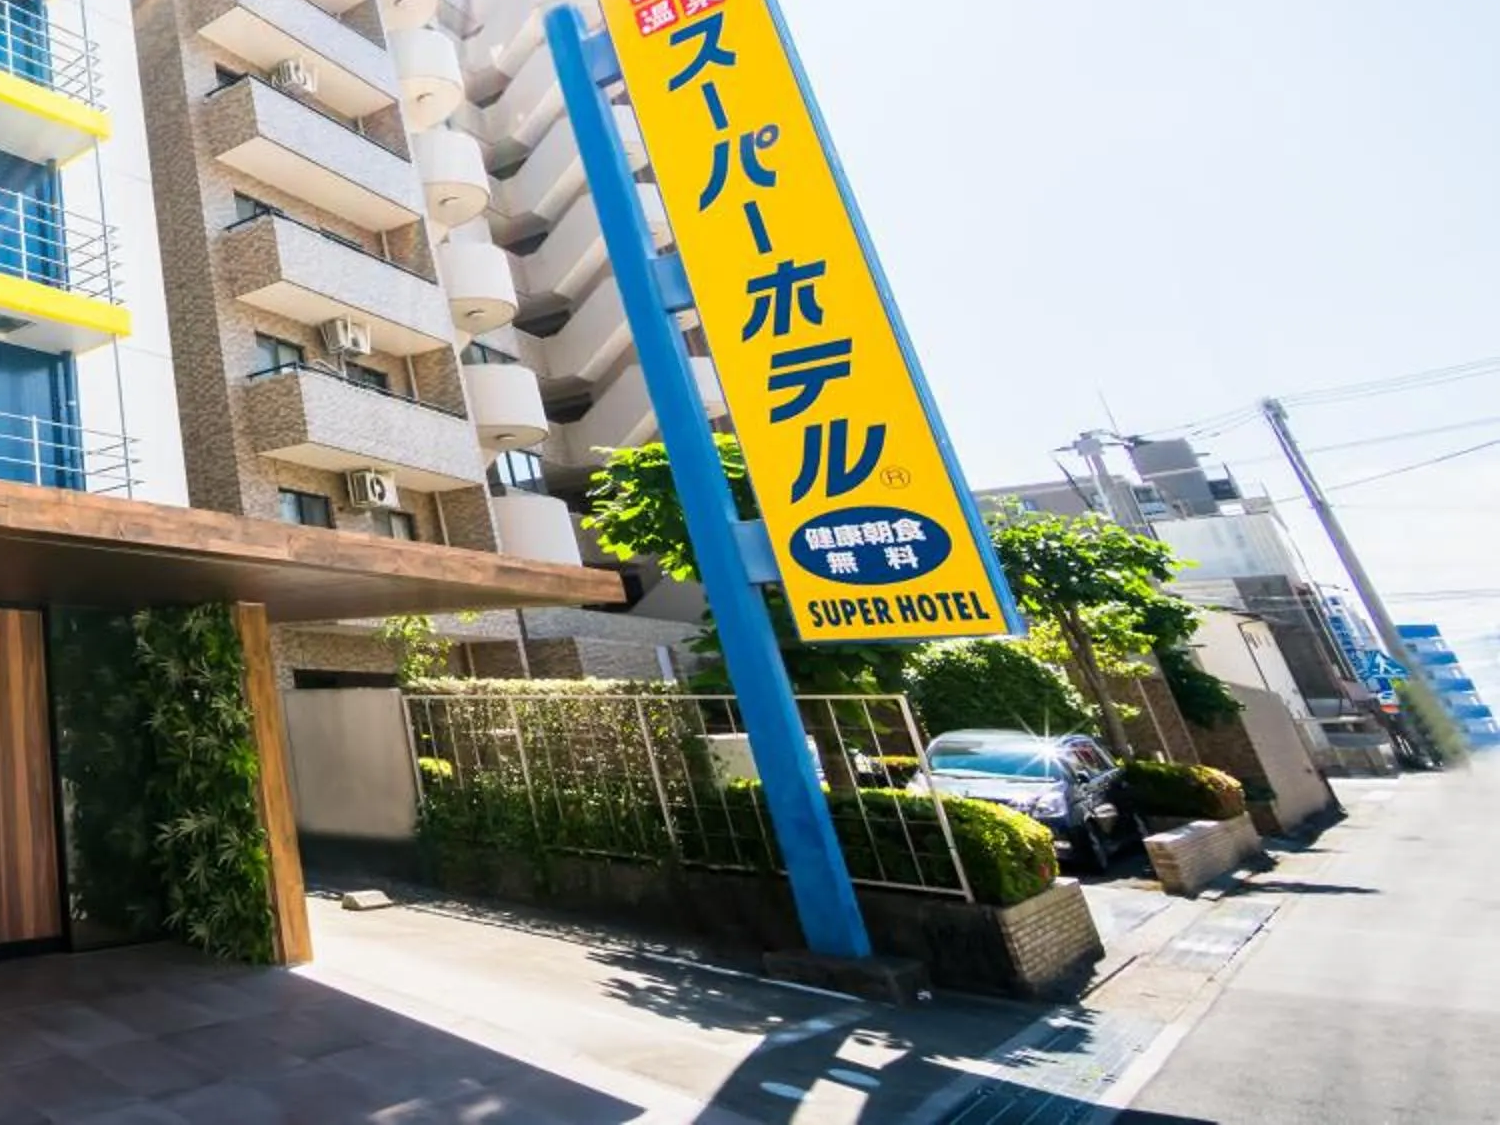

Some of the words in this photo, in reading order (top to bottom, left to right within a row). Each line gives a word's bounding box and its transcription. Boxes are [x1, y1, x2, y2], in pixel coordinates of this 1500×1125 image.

[668, 11, 887, 504] スーパーホテル
[805, 518, 927, 551] 健康朝食
[808, 597, 895, 627] SUPER
[896, 591, 990, 623] HOTEL
